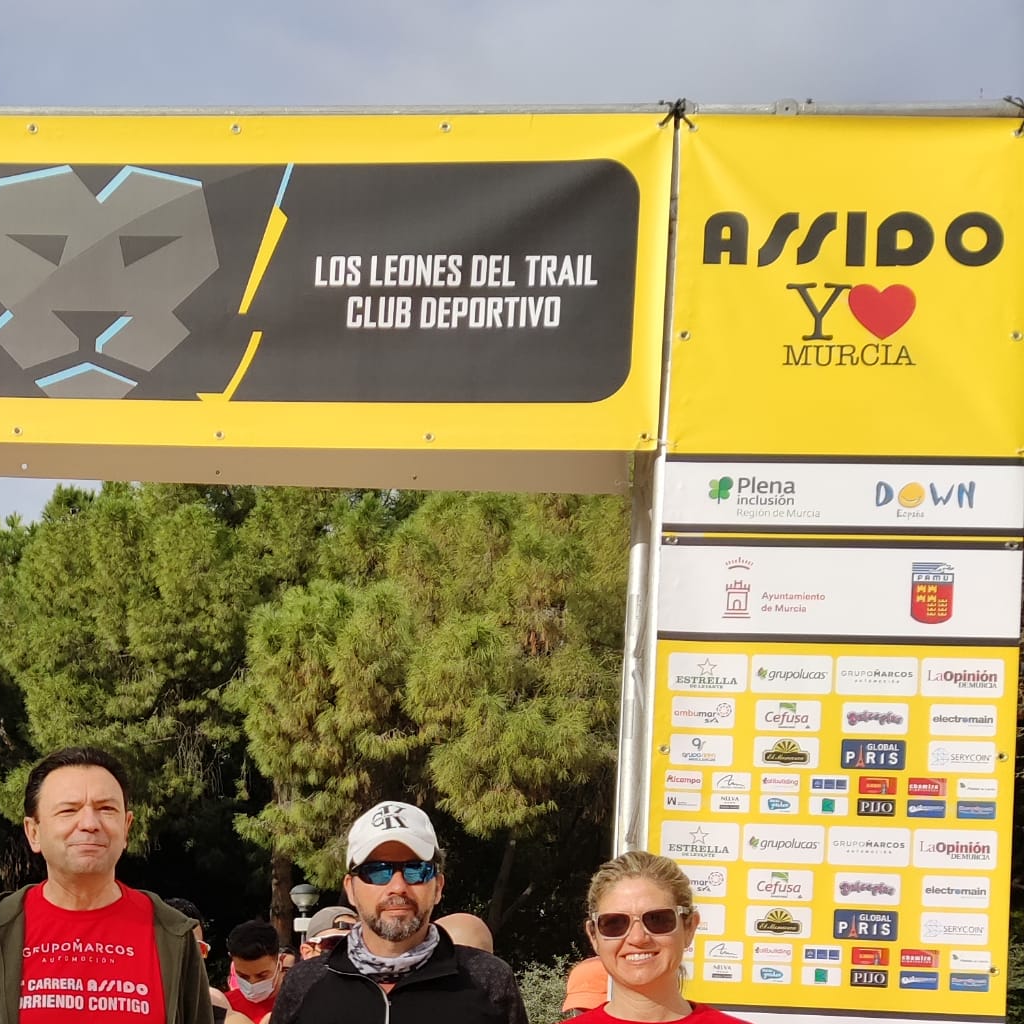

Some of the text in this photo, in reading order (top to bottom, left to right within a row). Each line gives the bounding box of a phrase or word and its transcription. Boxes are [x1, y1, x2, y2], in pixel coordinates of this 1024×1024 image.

[702, 211, 1005, 267] ASSIDO
[314, 254, 598, 287] LOS LEONES DEL TRAIL
[346, 296, 562, 329] CLUB DEPORTIVO
[786, 281, 853, 341] Y
[782, 343, 917, 367] MURCIA
[737, 476, 796, 494] Plena
[736, 494, 795, 506] inclusión
[736, 508, 821, 519] Región de Murcia
[761, 591, 826, 601] Ayuntamiento
[761, 603, 807, 612] de Murcia
[676, 675, 738, 685] ESTRELLA
[768, 668, 827, 681] grupolucas
[764, 711, 809, 726] Cefusa
[932, 715, 994, 725] electromain
[866, 743, 900, 752] GLOBAL
[860, 801, 893, 813] PIJO
[668, 843, 729, 854] ESTRELLA
[760, 838, 818, 851] grupolucas
[756, 880, 802, 895] Cefusa
[925, 886, 987, 896] electromain
[859, 913, 892, 922] GLOBAL
[853, 972, 886, 983] PIJO
[28, 978, 84, 992] CARRERA
[87, 979, 149, 996] ASSIDO
[88, 997, 150, 1015] CONTIGO
